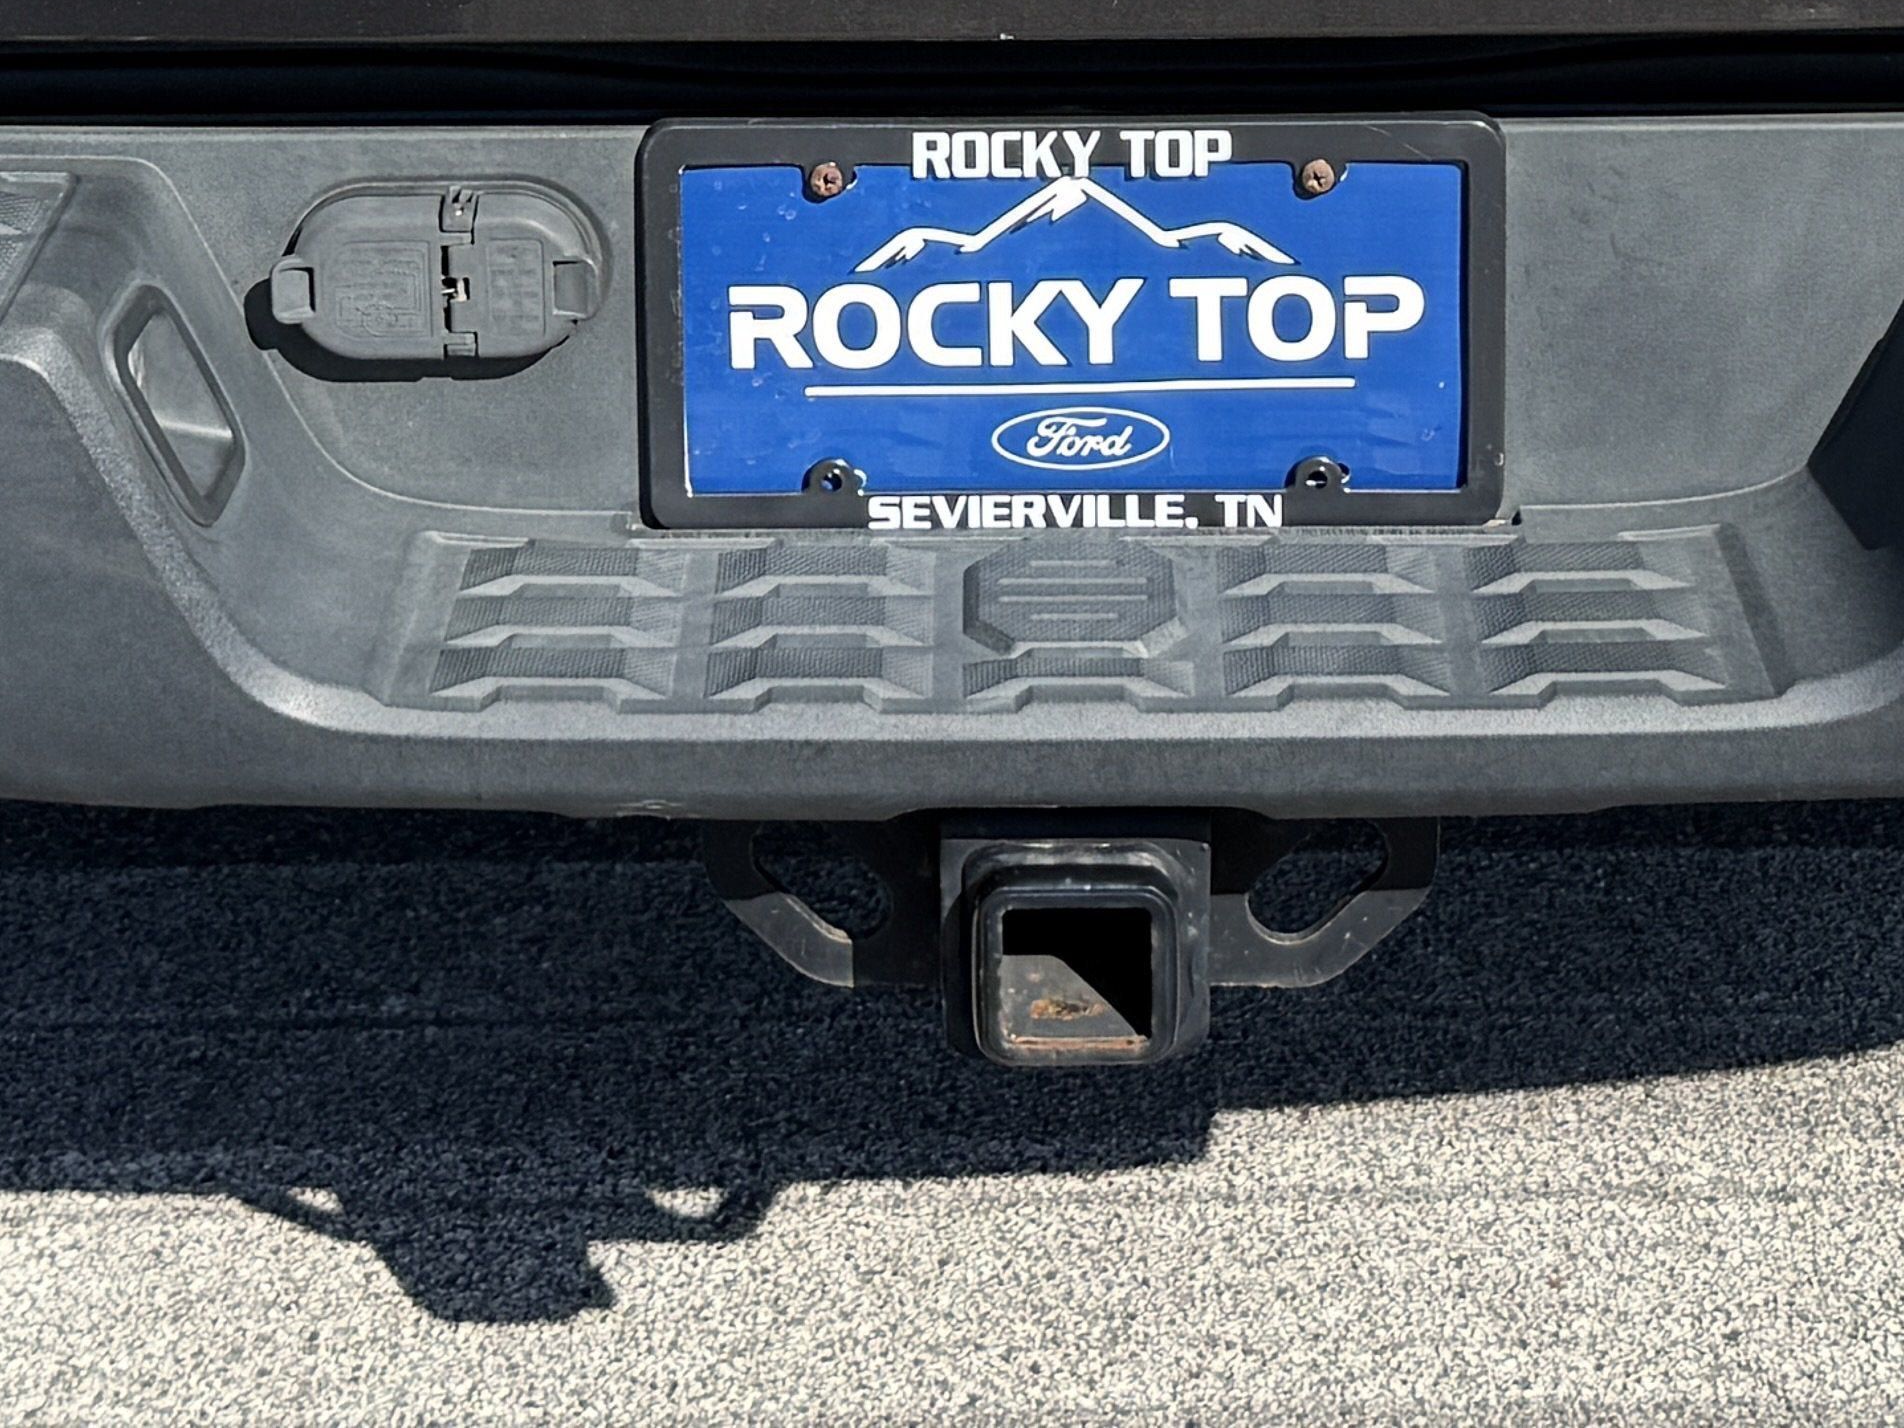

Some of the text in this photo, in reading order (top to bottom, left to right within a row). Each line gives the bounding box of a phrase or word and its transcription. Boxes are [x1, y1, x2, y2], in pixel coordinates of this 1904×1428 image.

[911, 130, 1232, 179] ROCKY TOP
[728, 275, 1426, 370] ROCKY TOP
[1026, 417, 1132, 458] Ford
[1216, 493, 1283, 529] TN
